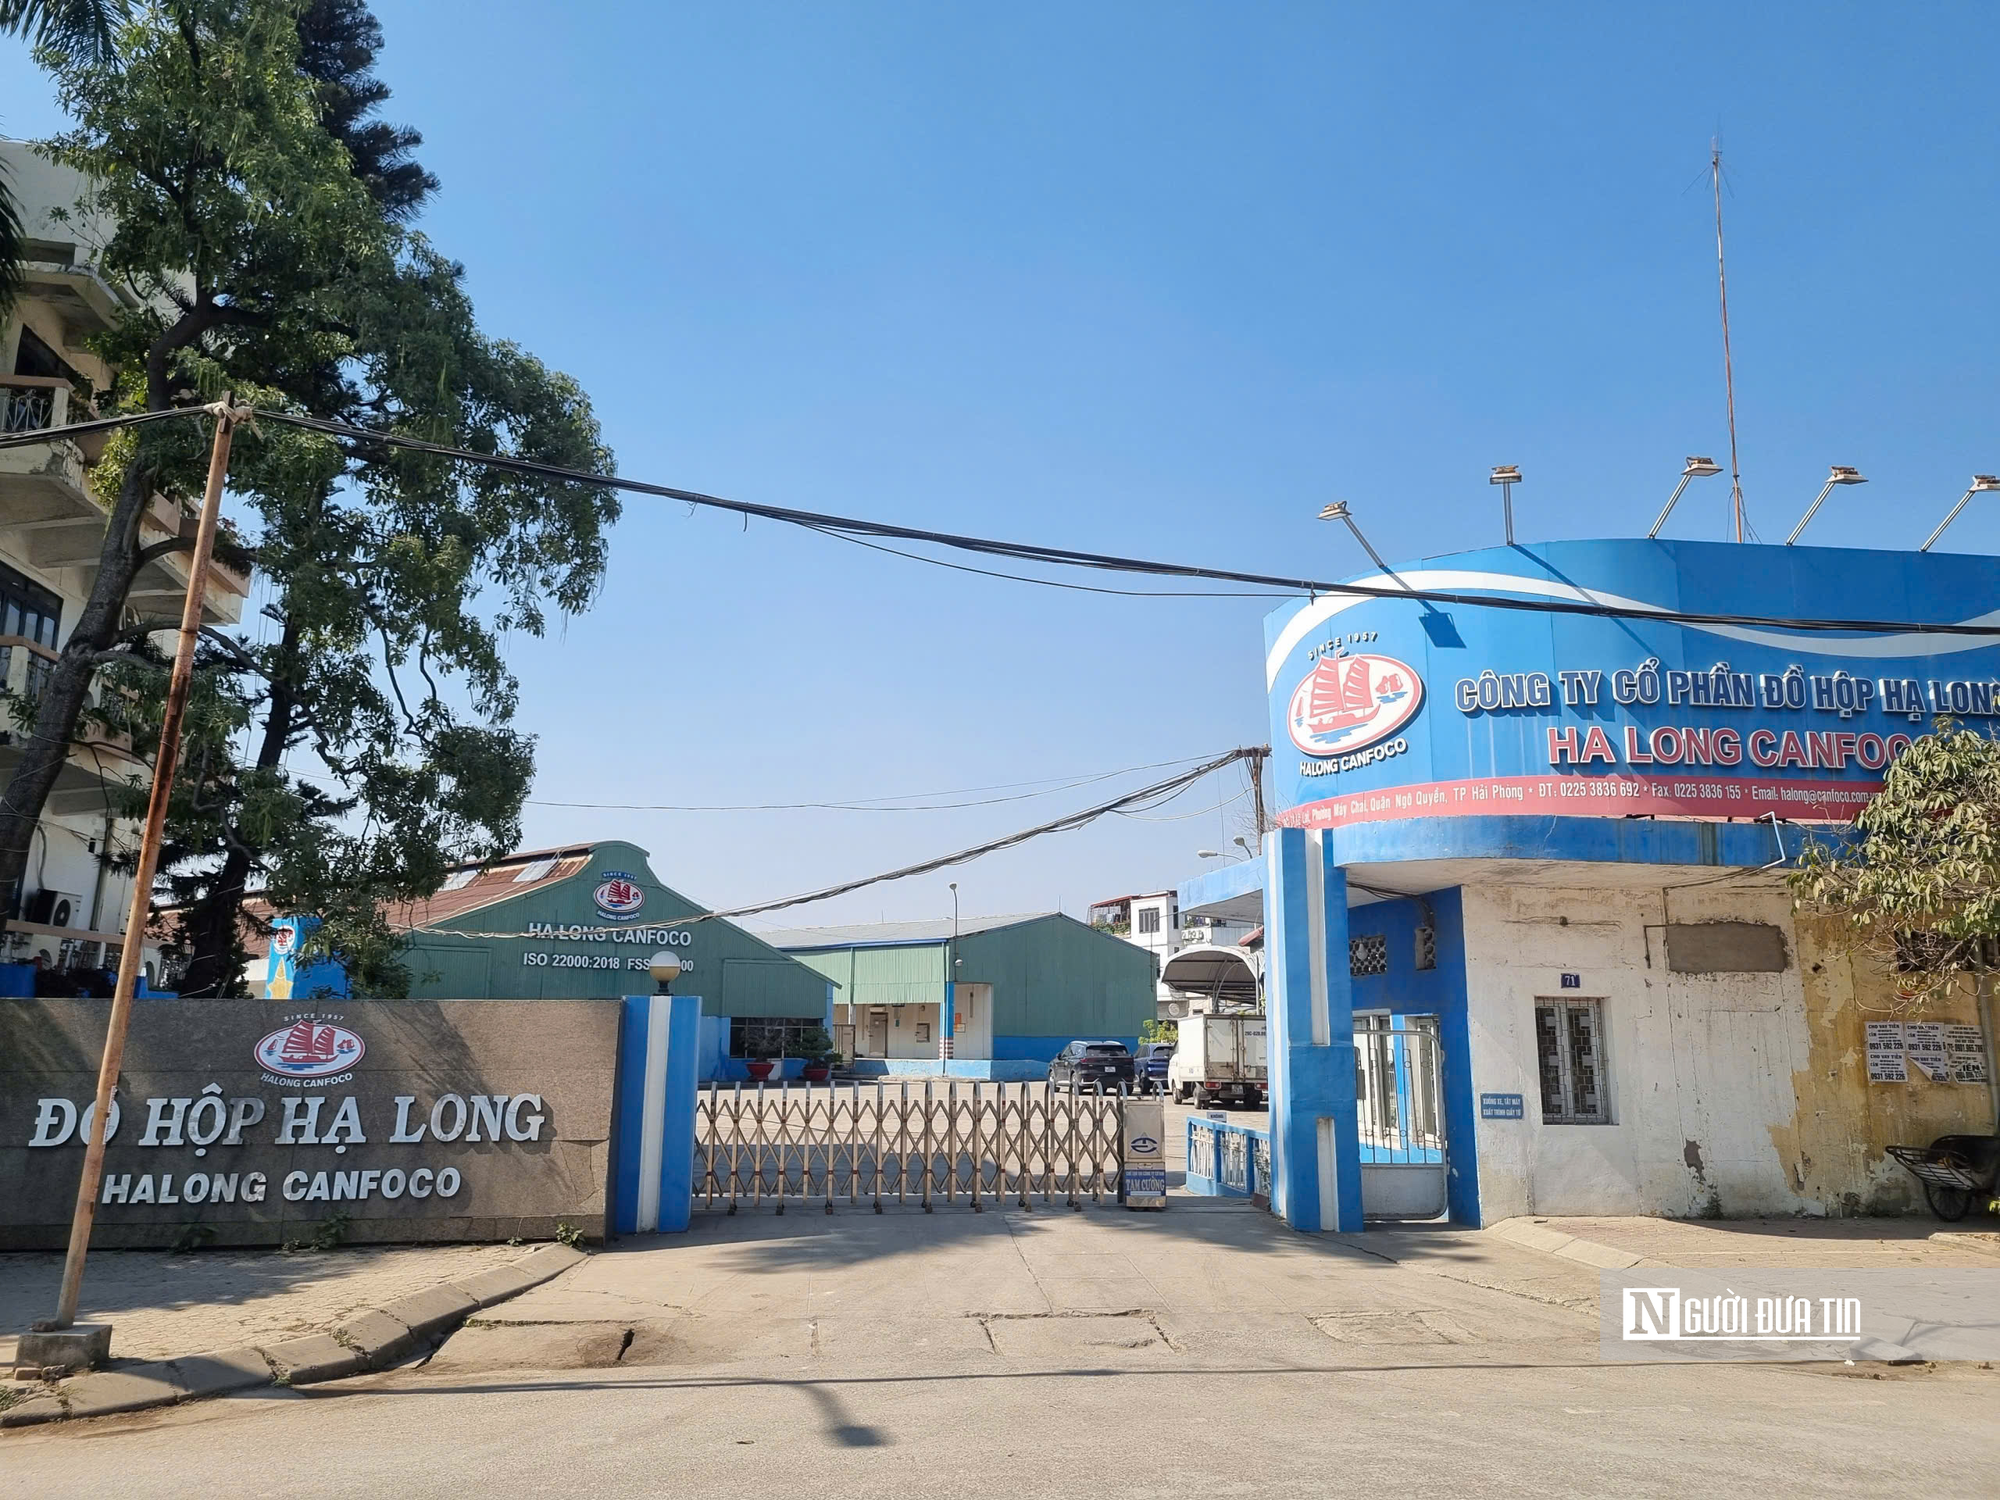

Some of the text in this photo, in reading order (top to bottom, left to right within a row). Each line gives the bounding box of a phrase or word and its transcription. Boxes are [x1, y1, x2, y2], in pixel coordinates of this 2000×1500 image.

[1307, 631, 1378, 660] SINCE 1957
[1455, 669, 1550, 712] CÔNG
[1559, 670, 1602, 704] TY
[1612, 657, 1660, 704] CỔ
[1667, 662, 1756, 707] PHẦN
[1760, 665, 1806, 709] ĐỒ
[1810, 670, 1875, 718] HỘP
[1878, 678, 1926, 721] HẠ
[1300, 738, 1407, 776] HALONG CANFOCO
[1547, 726, 1935, 770] HA LONG CANFOC
[1334, 803, 1347, 818] Máy
[1370, 796, 1390, 812] Quận
[1395, 792, 1412, 809] Ngô
[1416, 787, 1448, 806] Quyền,
[1453, 787, 1467, 801] TP
[1472, 784, 1488, 800] Hải
[1492, 784, 1523, 801] Phòng
[1538, 782, 1557, 797] ĐT:
[1560, 782, 1586, 797] 0225
[1589, 782, 1616, 797] 3836
[1620, 782, 1640, 797] 692
[1674, 783, 1697, 798] 0225
[1700, 784, 1723, 799] 3836
[1725, 785, 1741, 800] 155
[1752, 785, 1778, 800] Email:
[597, 910, 640, 920] HALONG CANFOCO
[528, 922, 692, 946] HA LONG CANFOCO
[523, 953, 650, 971] ISO 22000:2018 FSS
[1564, 975, 1576, 986] 71
[283, 1013, 344, 1022] SINCE 1957
[260, 1072, 353, 1088] HALONG CANFOCO
[138, 1082, 266, 1157] HỘP
[274, 1096, 367, 1154] HẠ
[389, 1093, 545, 1143] LONG
[101, 1167, 461, 1204] HALONG CANFOCO
